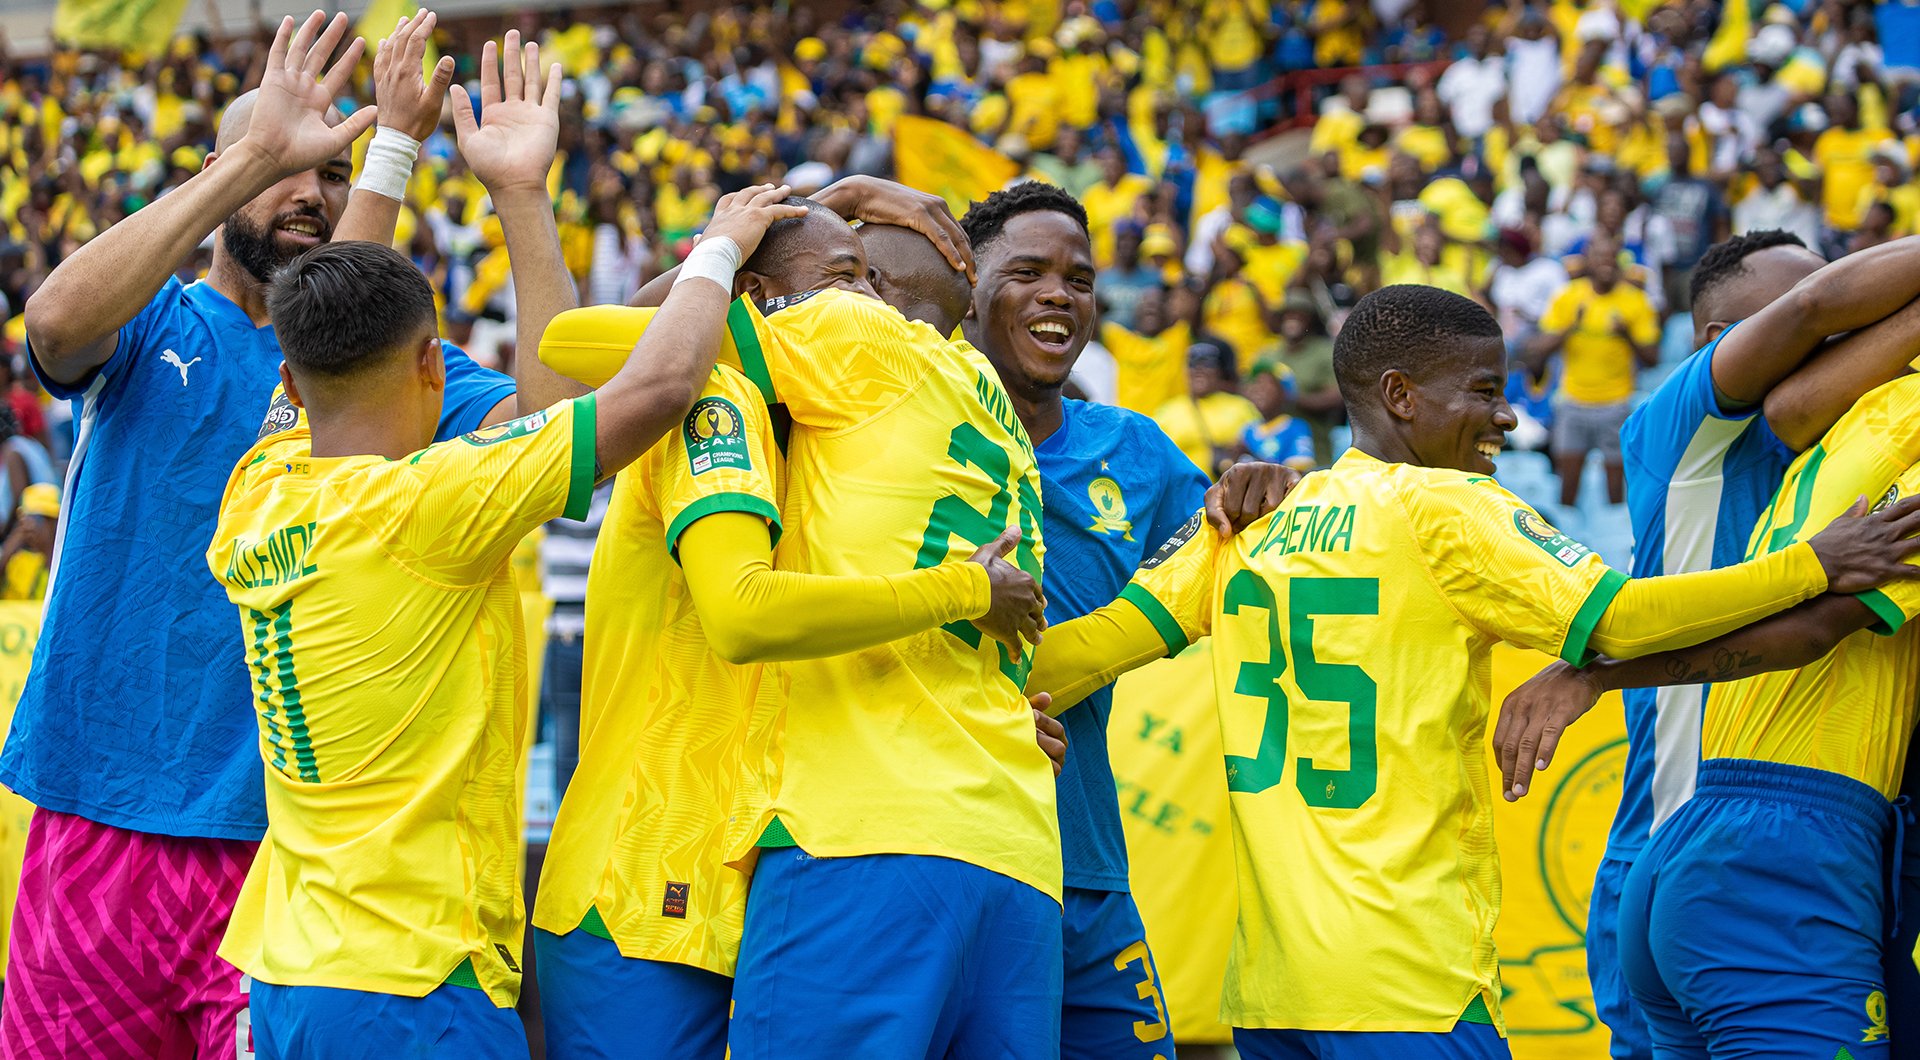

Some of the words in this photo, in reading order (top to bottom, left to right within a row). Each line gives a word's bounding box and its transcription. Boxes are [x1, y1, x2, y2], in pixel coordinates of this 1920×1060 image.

[699, 437, 736, 450] CAF
[226, 521, 318, 589] ALLENDE
[1222, 568, 1379, 810] 35
[1138, 711, 1183, 754] YA
